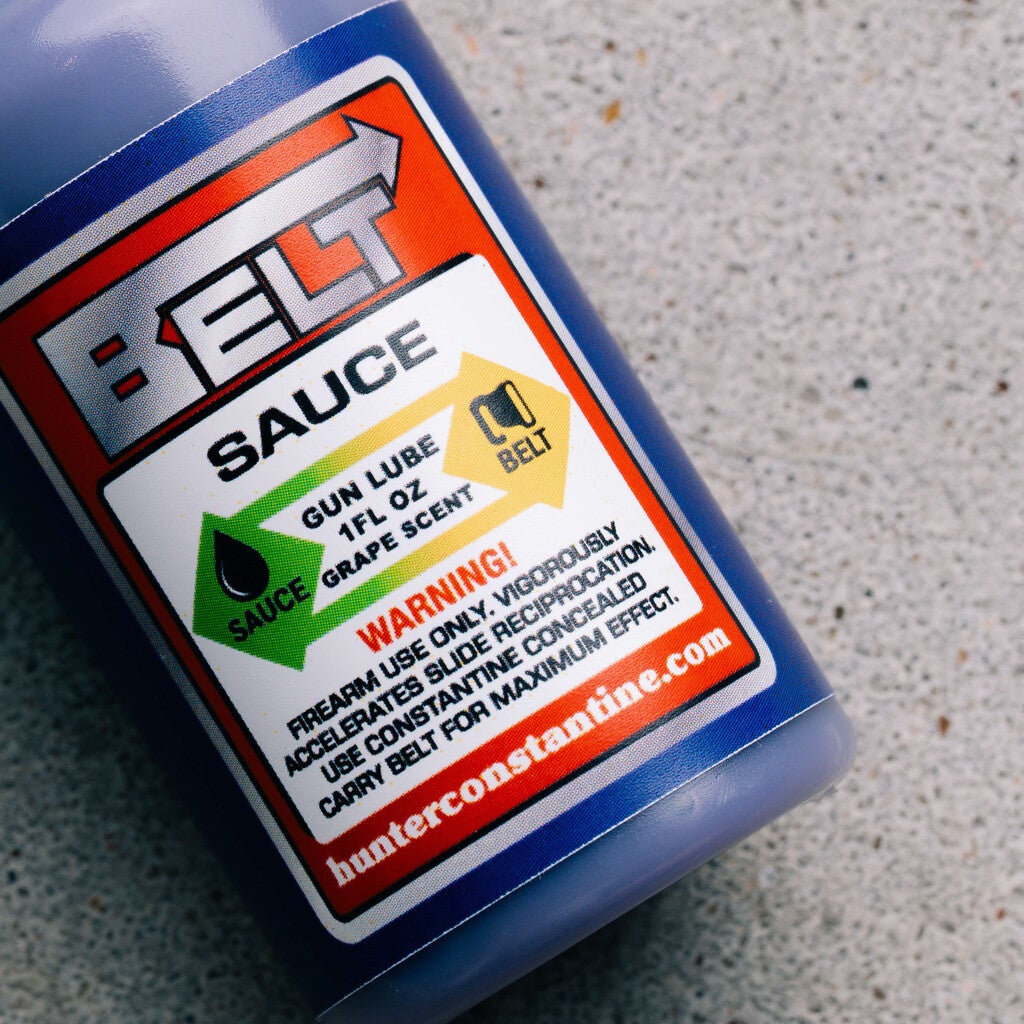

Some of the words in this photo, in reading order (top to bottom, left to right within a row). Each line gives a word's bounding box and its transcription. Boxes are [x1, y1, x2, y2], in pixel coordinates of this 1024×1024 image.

[32, 114, 403, 464] BELT
[207, 320, 437, 482] SAUCE
[301, 482, 364, 530] GUN
[365, 434, 440, 488] LUBE
[496, 428, 551, 475] BELT
[322, 531, 399, 589] GRAPE
[405, 484, 475, 540] SCENT
[338, 504, 386, 543] 1FL
[390, 478, 429, 512] OZ
[227, 577, 311, 643] SAUCE
[284, 681, 424, 777] ACCELERATES
[427, 636, 491, 686] SLIDE
[495, 535, 656, 645] RECIPROCATION.
[287, 675, 380, 741] FIREARM
[379, 644, 429, 679] USE
[428, 606, 495, 653] ONLY.
[493, 521, 622, 610] VIGOROUSLY
[320, 747, 362, 783] USE
[366, 648, 522, 753] CONSTANTINE
[522, 572, 647, 660] CONCEALED
[356, 541, 517, 654] WARNING!
[318, 775, 384, 819] CARRY
[389, 734, 439, 776] BELT
[444, 705, 489, 742] FOR
[491, 630, 608, 712] MAXIMUM
[609, 585, 679, 639] EFFECT.
[325, 627, 731, 888] hunterconstantine.com
